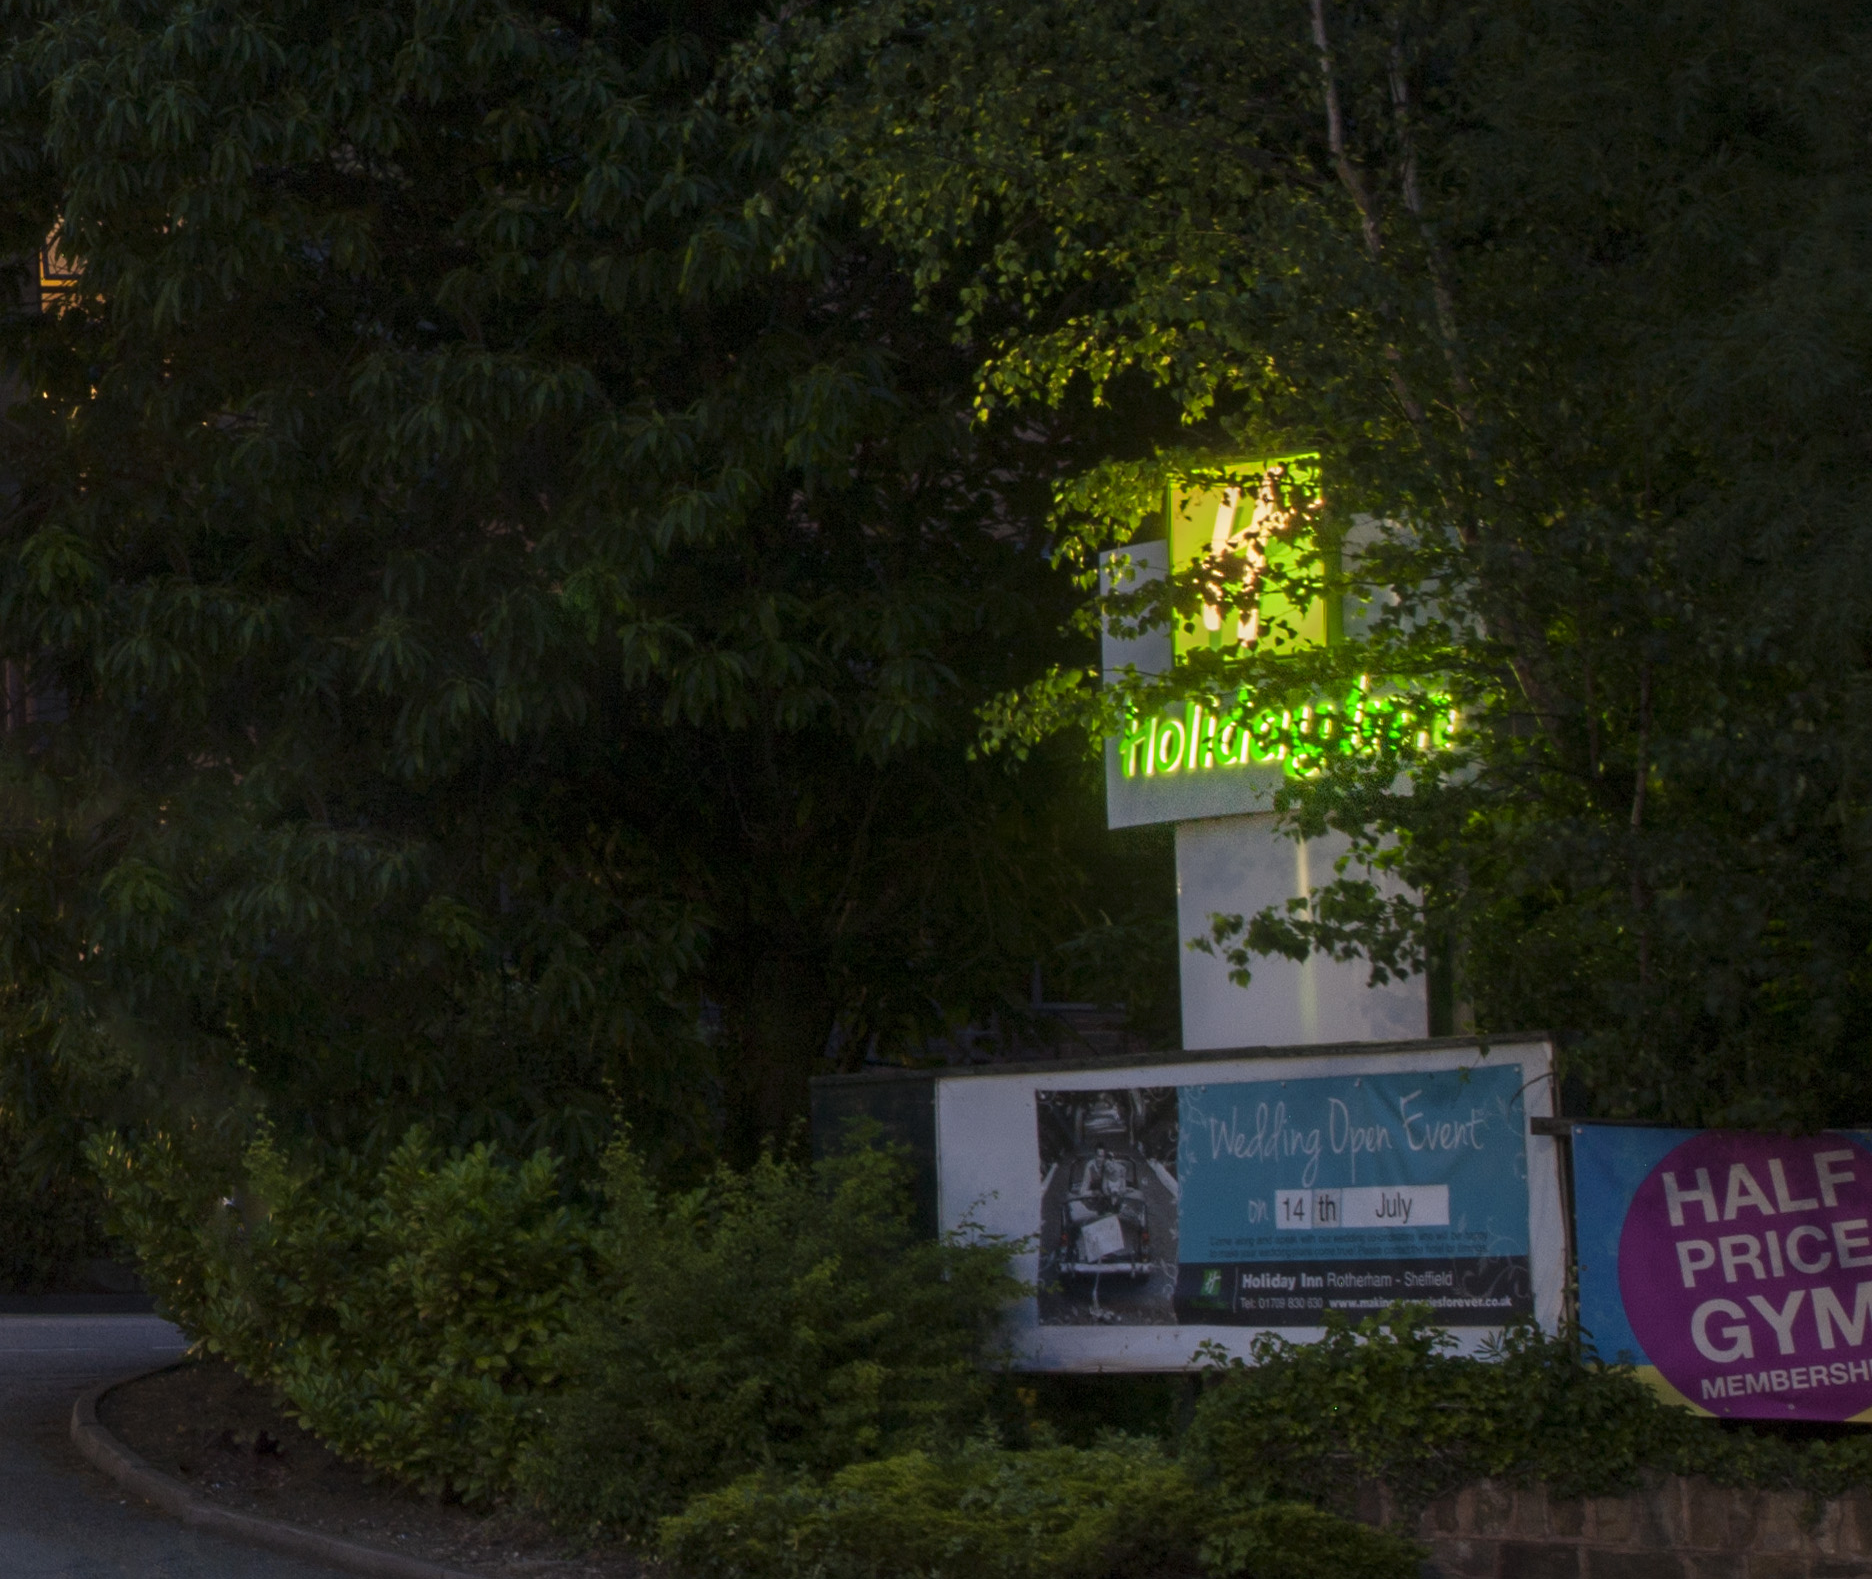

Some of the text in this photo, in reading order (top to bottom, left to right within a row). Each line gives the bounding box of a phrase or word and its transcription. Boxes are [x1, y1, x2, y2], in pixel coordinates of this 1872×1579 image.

[1210, 1089, 1486, 1188] Wedding Open Event
[1282, 1197, 1305, 1221] 14
[1319, 1194, 1337, 1222] th
[1375, 1192, 1412, 1224] July
[1661, 1149, 1856, 1227] HALF
[1242, 1272, 1296, 1291] Holiday
[1301, 1272, 1324, 1288] Inn
[1327, 1272, 1391, 1287] Rotherham
[1404, 1271, 1453, 1287] Sheffield
[1675, 1219, 1872, 1288] PRICE
[1691, 1281, 1872, 1363] GYM
